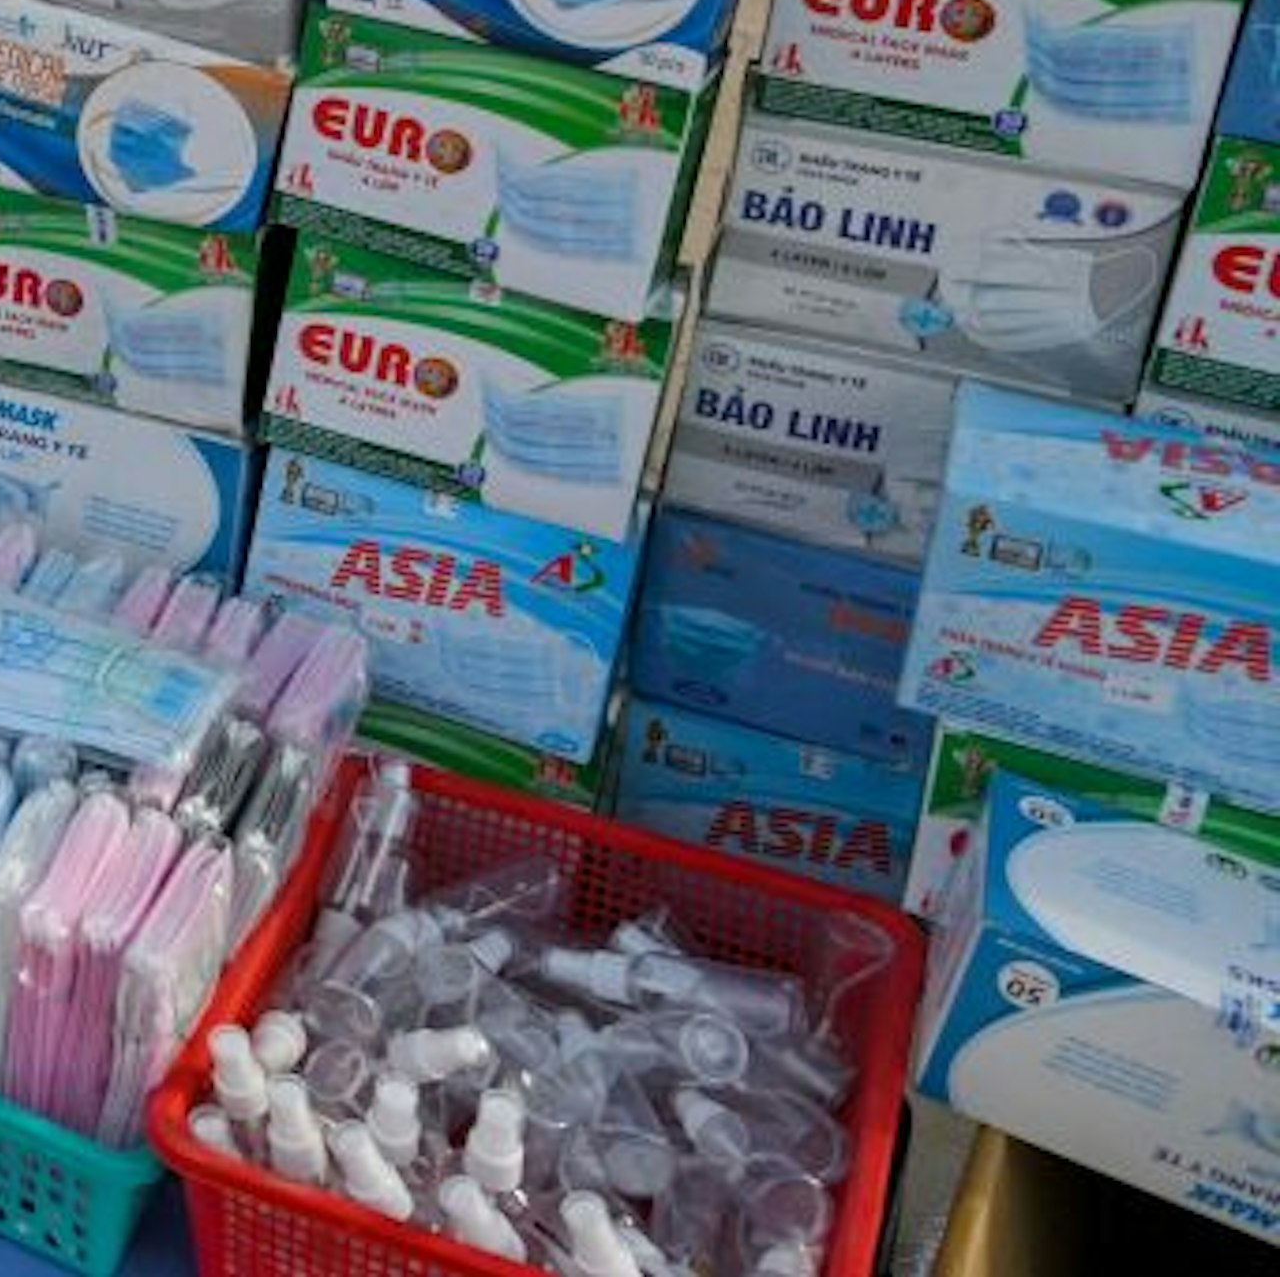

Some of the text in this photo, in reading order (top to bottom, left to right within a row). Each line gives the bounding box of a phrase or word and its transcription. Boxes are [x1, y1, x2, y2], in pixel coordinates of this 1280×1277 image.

[313, 97, 473, 174] EURO
[741, 186, 937, 254] BẢO LINH
[299, 324, 459, 399] EURO
[695, 386, 882, 453] BẢO LINH
[331, 539, 506, 617] ASIA
[1035, 595, 1273, 682] ASIA
[705, 800, 892, 876] ASIA
